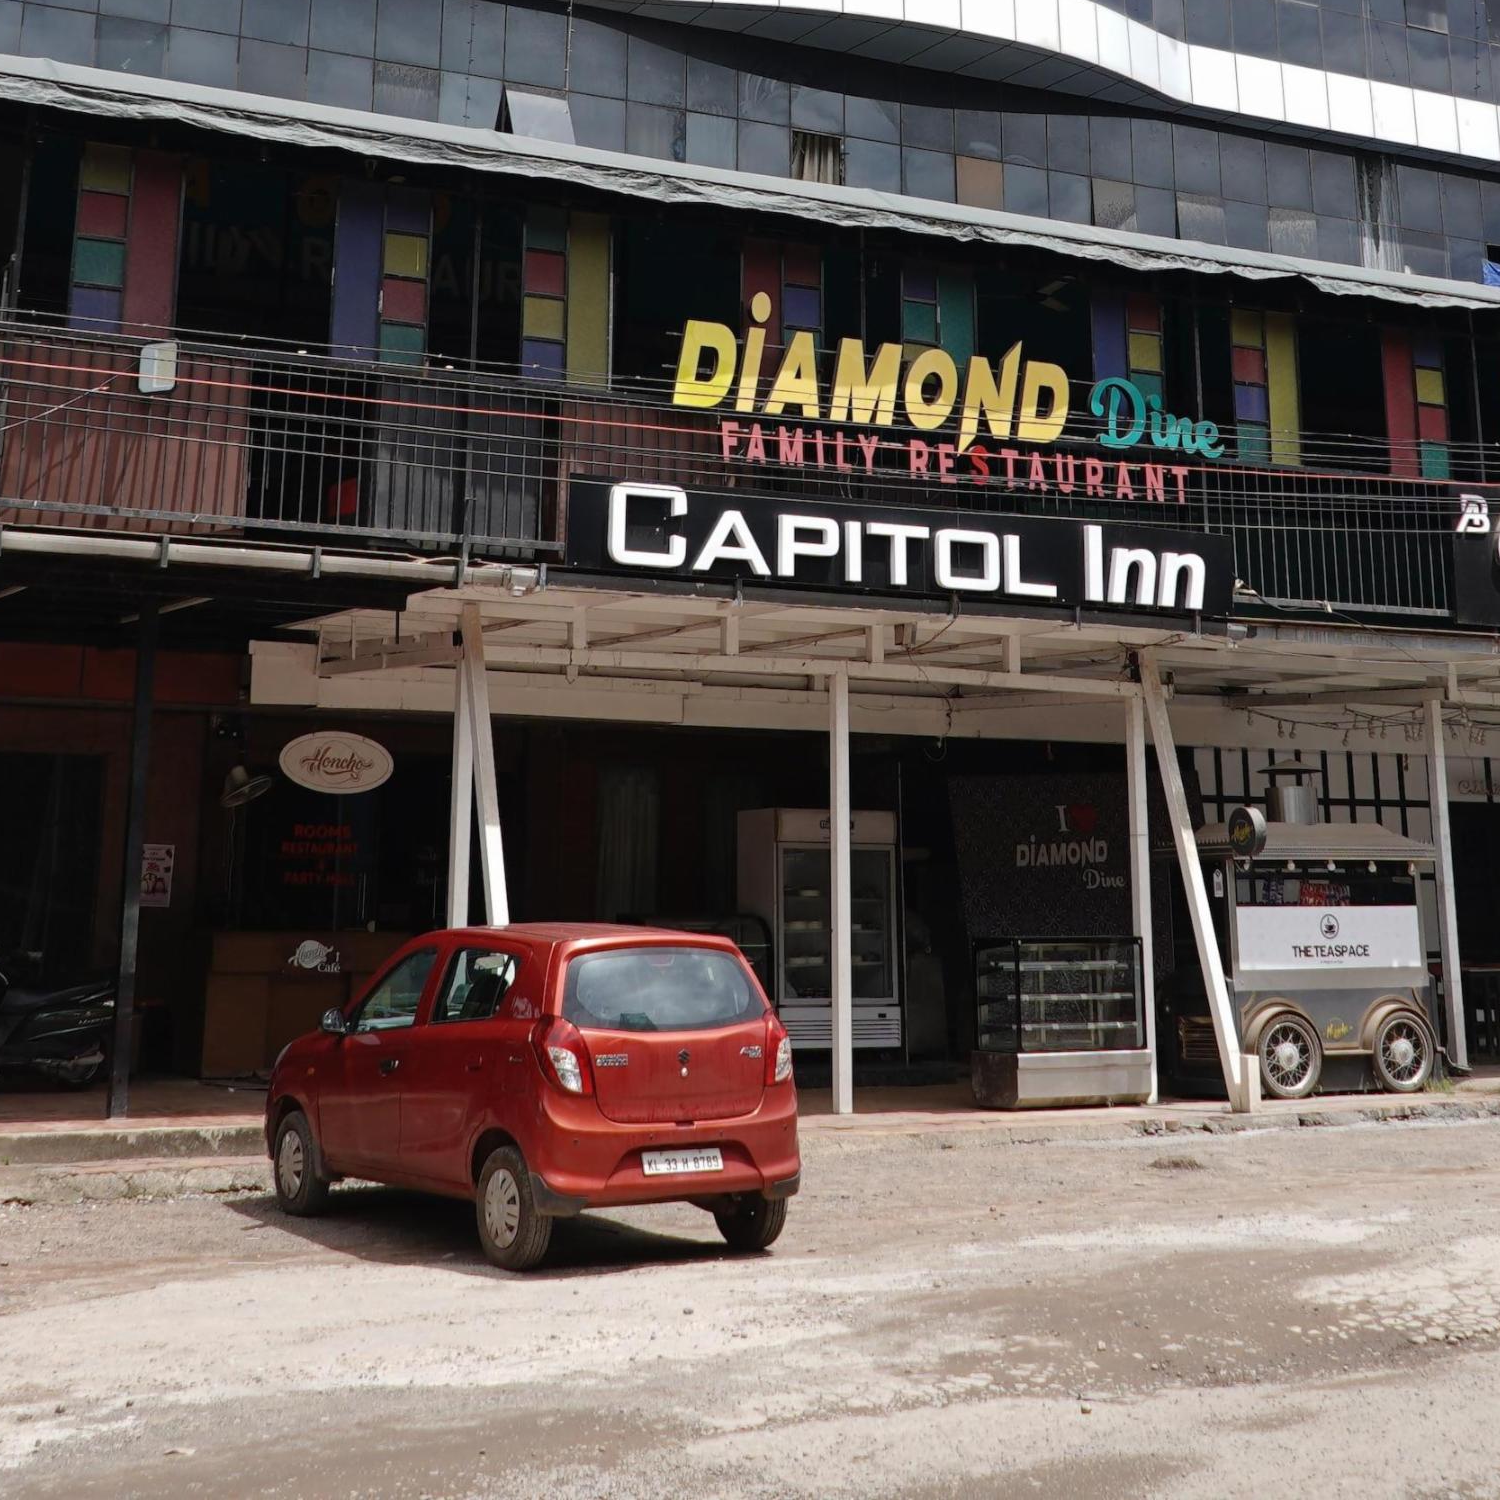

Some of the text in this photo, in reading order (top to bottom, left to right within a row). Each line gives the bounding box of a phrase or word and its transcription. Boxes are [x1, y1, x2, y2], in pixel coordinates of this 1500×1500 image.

[1090, 377, 1225, 458] Dine
[721, 421, 1190, 504] FAMILY RESTAURANT
[1083, 523, 1207, 610] Inn
[301, 746, 374, 779] Honcho
[1055, 804, 1070, 832] I
[1082, 868, 1126, 890] Dine
[647, 1158, 660, 1171] KL
[665, 1158, 678, 1171] 33
